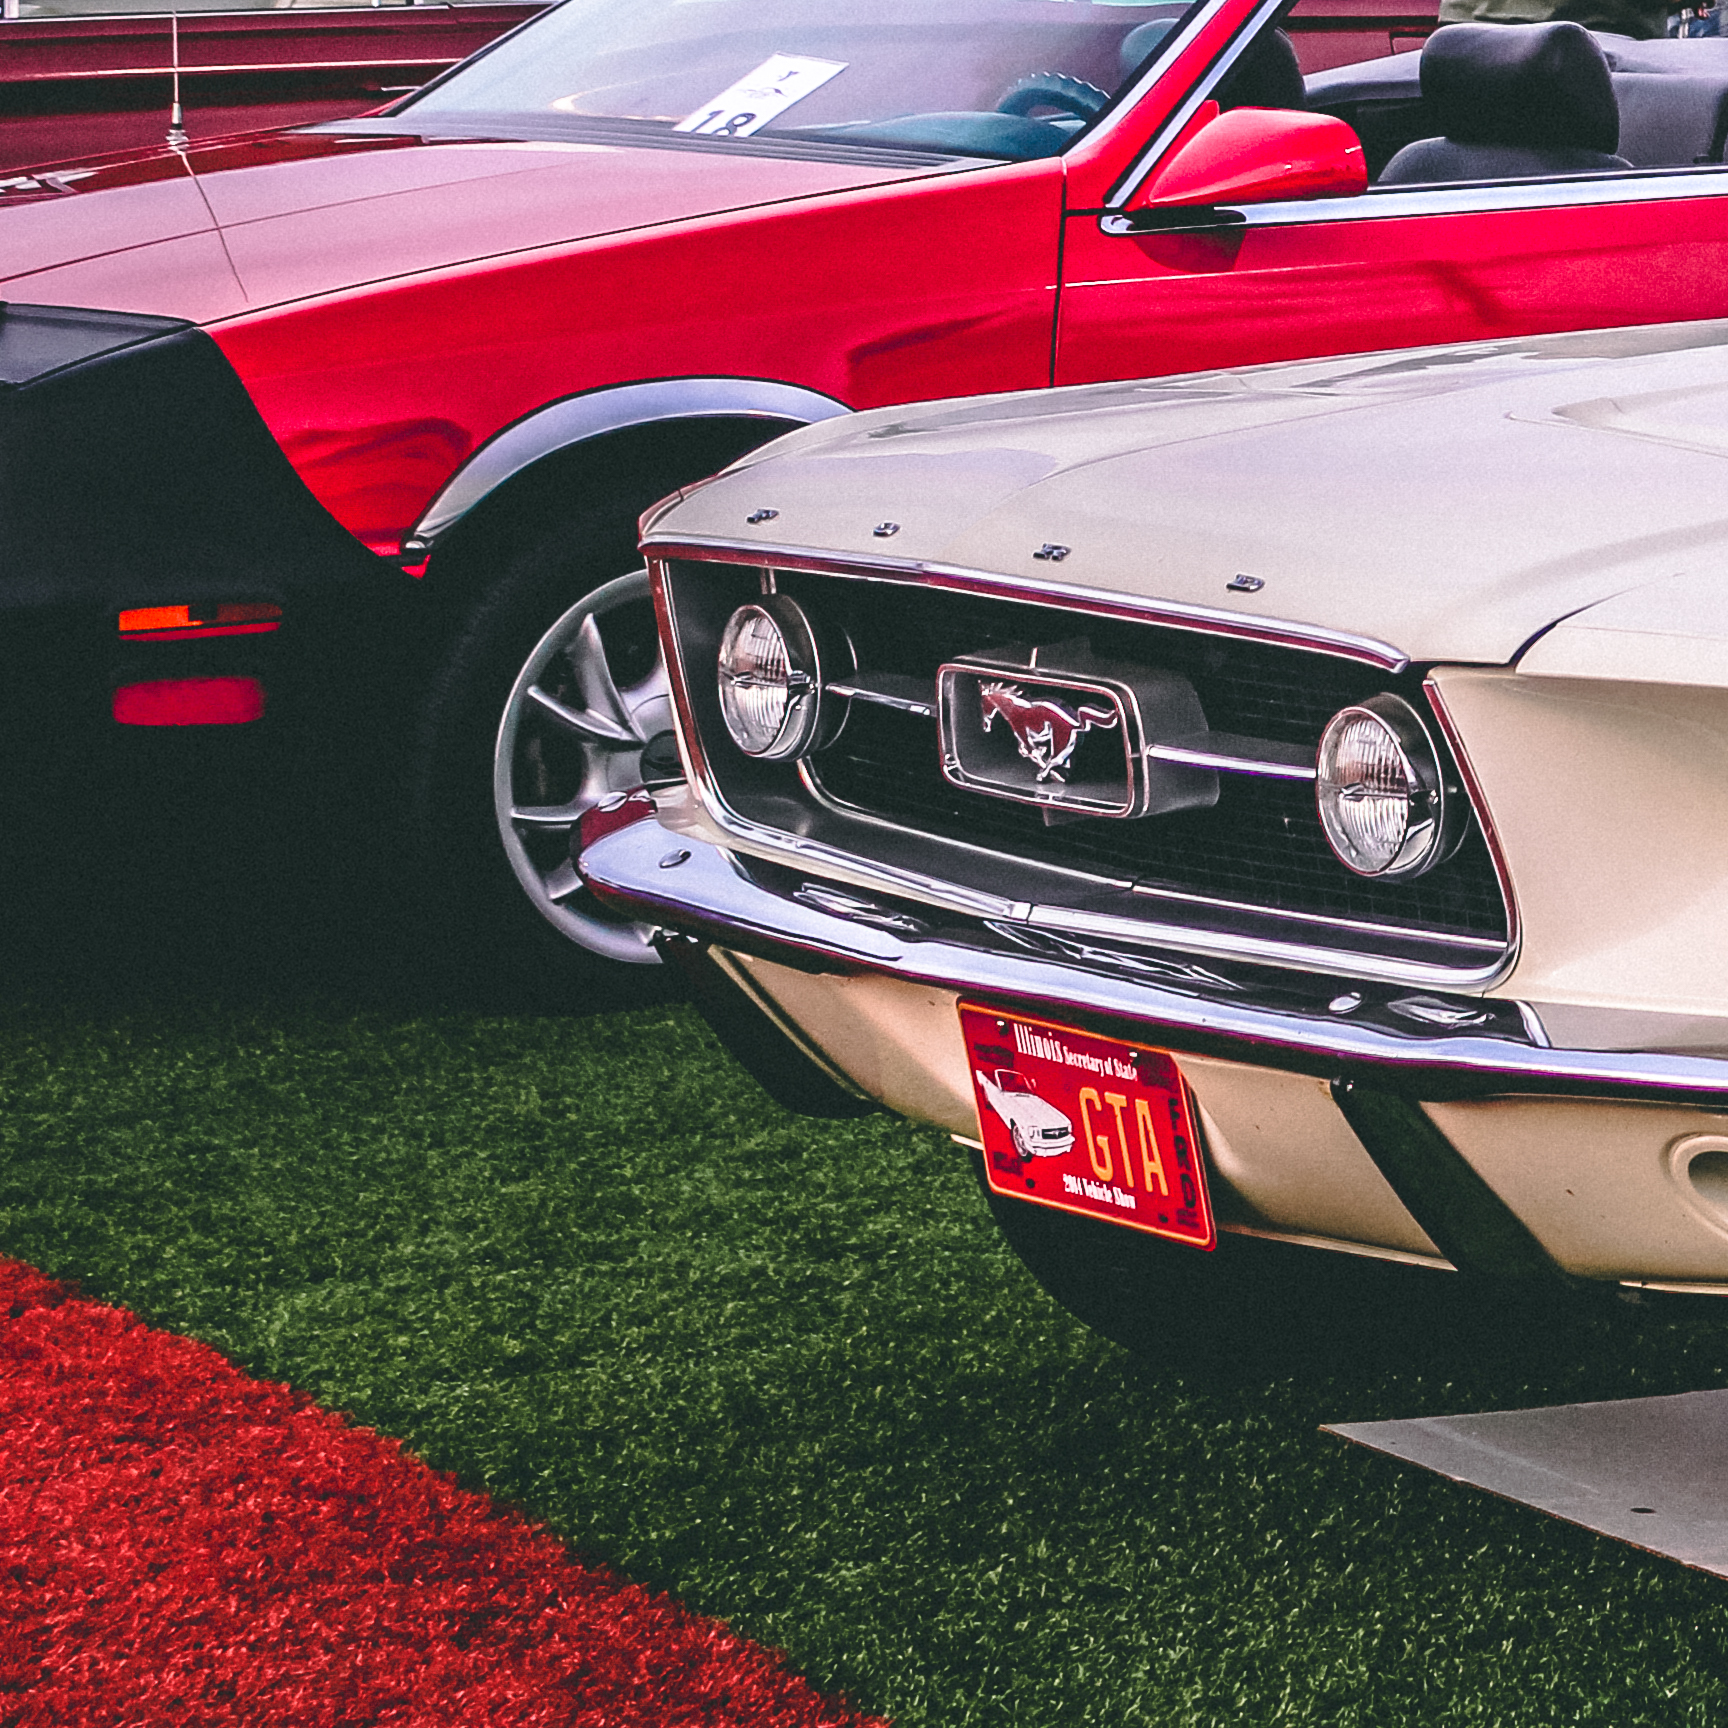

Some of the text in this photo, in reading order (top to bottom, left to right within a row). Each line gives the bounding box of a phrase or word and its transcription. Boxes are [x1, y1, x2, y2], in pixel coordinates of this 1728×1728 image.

[690, 109, 757, 136] 18
[1013, 1022, 1064, 1064] Illinois
[1078, 1086, 1170, 1197] GTA
